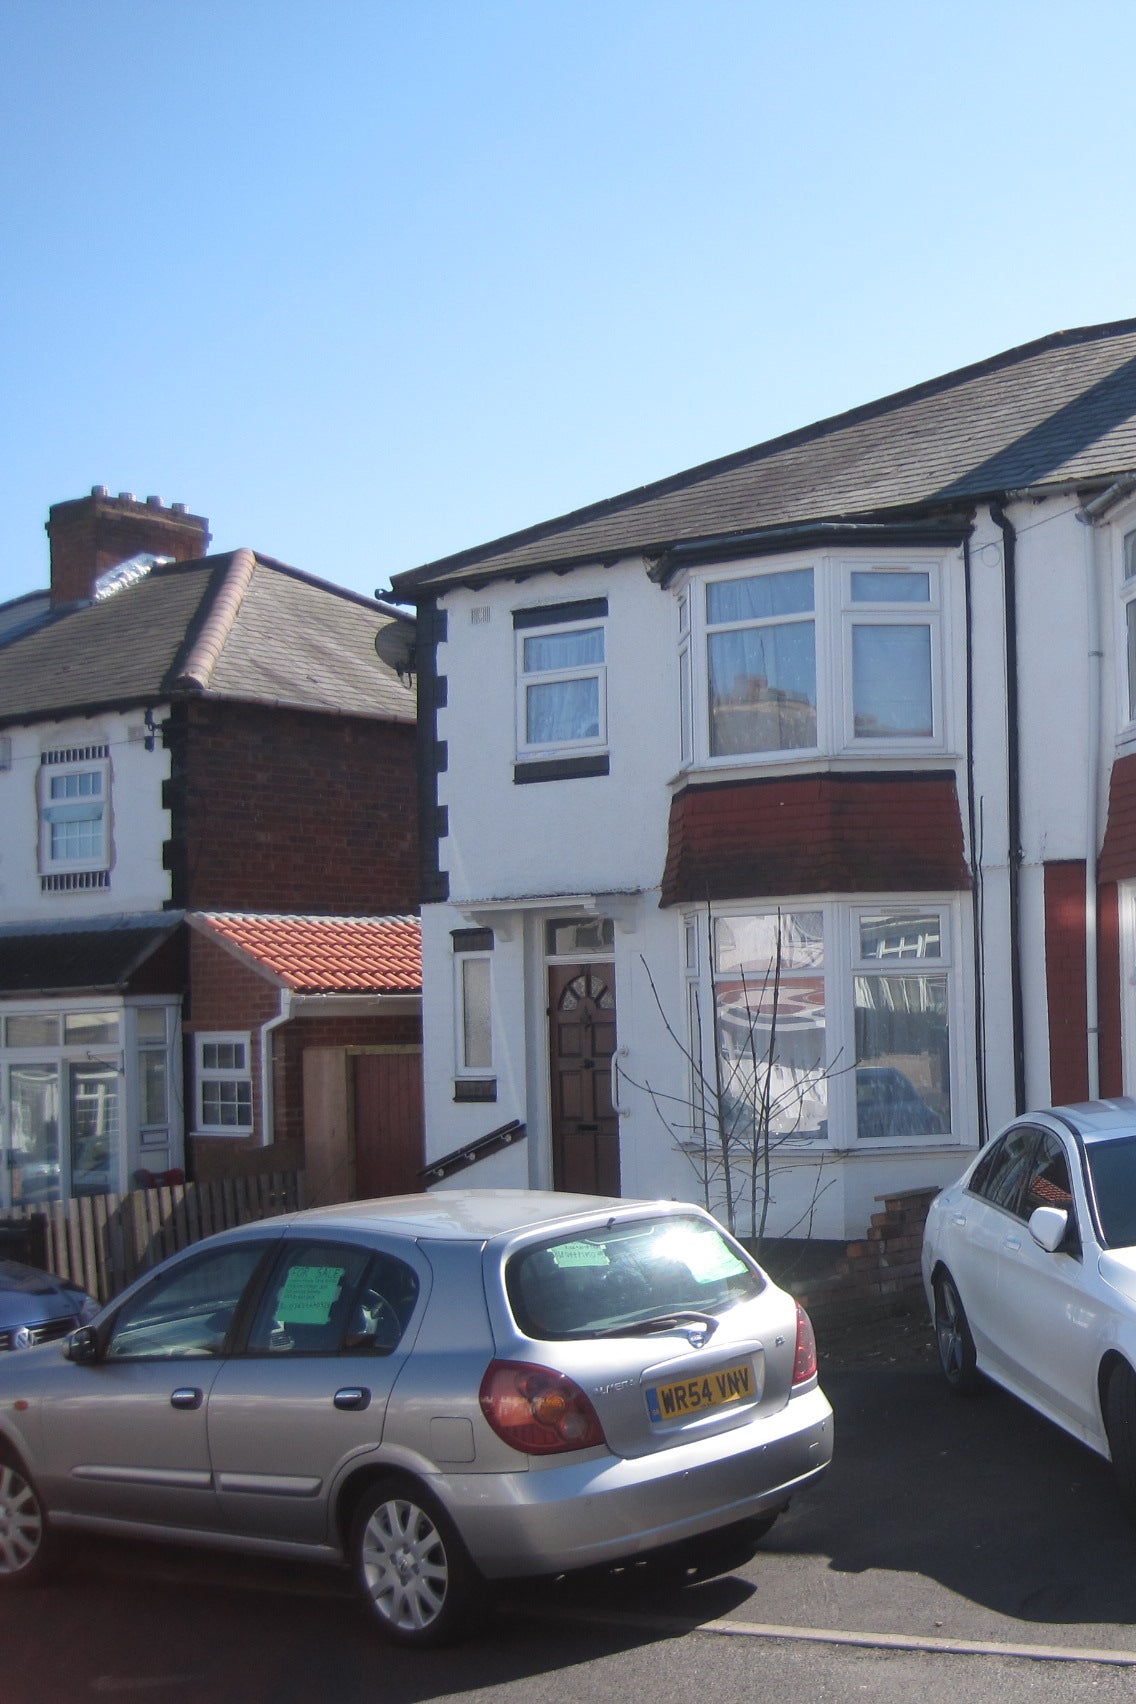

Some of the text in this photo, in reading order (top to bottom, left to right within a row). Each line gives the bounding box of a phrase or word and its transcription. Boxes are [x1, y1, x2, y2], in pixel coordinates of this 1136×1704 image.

[292, 1267, 342, 1279] FOR SALE
[660, 1378, 713, 1415] WR54
[715, 1367, 749, 1398] VNV
